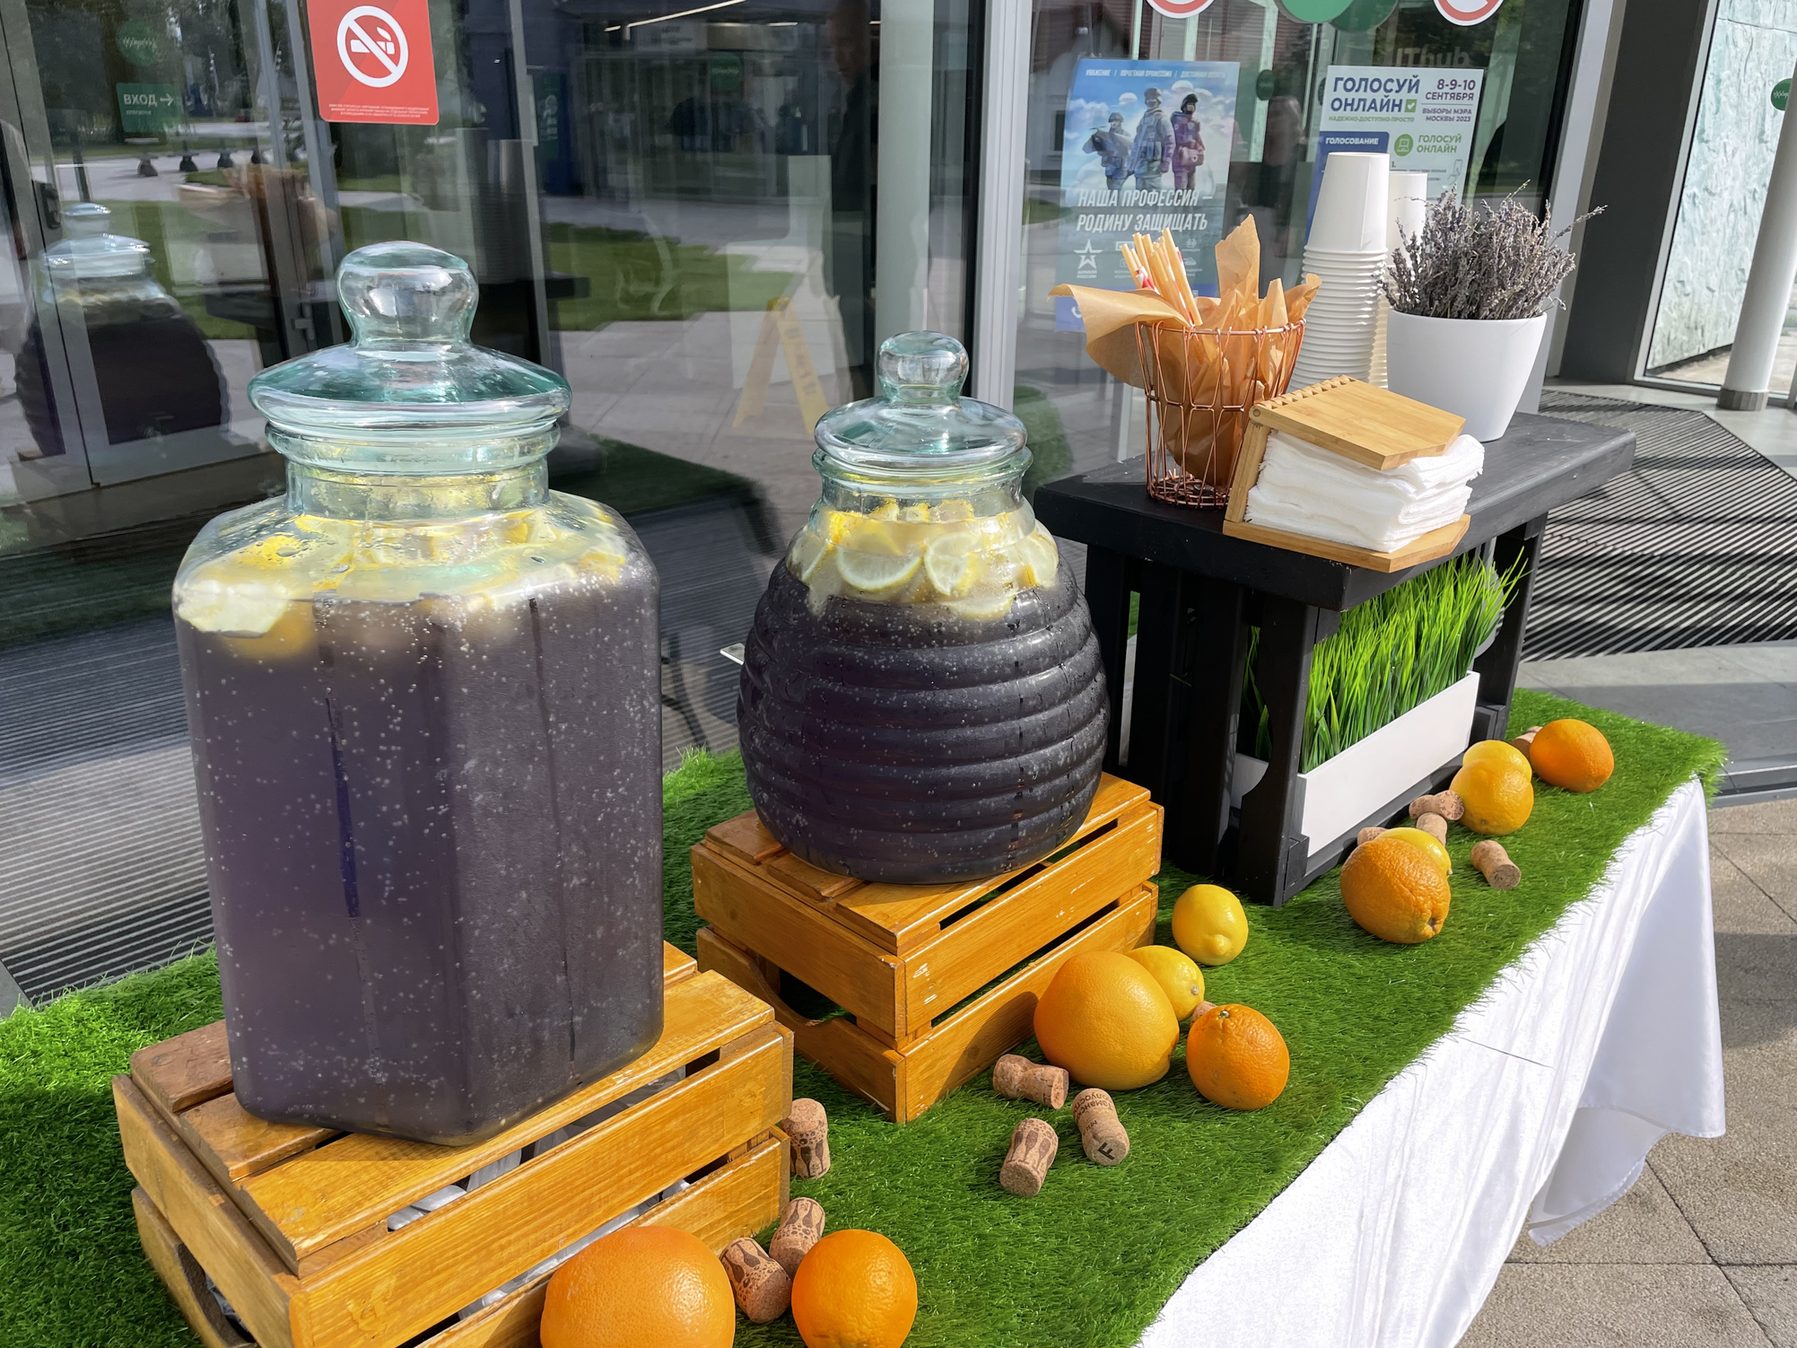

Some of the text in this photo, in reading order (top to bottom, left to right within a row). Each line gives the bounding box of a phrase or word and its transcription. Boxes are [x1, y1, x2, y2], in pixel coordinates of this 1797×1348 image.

[1333, 75, 1420, 94] ГОЛОСУЙ
[1437, 79, 1476, 91] 8-9-10
[123, 94, 158, 107] ВХОД
[1425, 91, 1474, 101] СЕНТЯБРЯ
[1331, 95, 1402, 113] ОНЛАЙН
[1422, 107, 1452, 115] ВЫБОРЫ
[1325, 137, 1379, 145] ГОЛОСОВАНИЕ
[1418, 133, 1462, 144] ГОЛОСУЙ
[1416, 142, 1457, 154] ОНЛАЙН
[1078, 189, 1118, 207] НАША
[1121, 189, 1199, 207] ПРОФЕССИЯ
[1076, 213, 1208, 233] РОДИНУ ЗАЩИЩАТЬ
